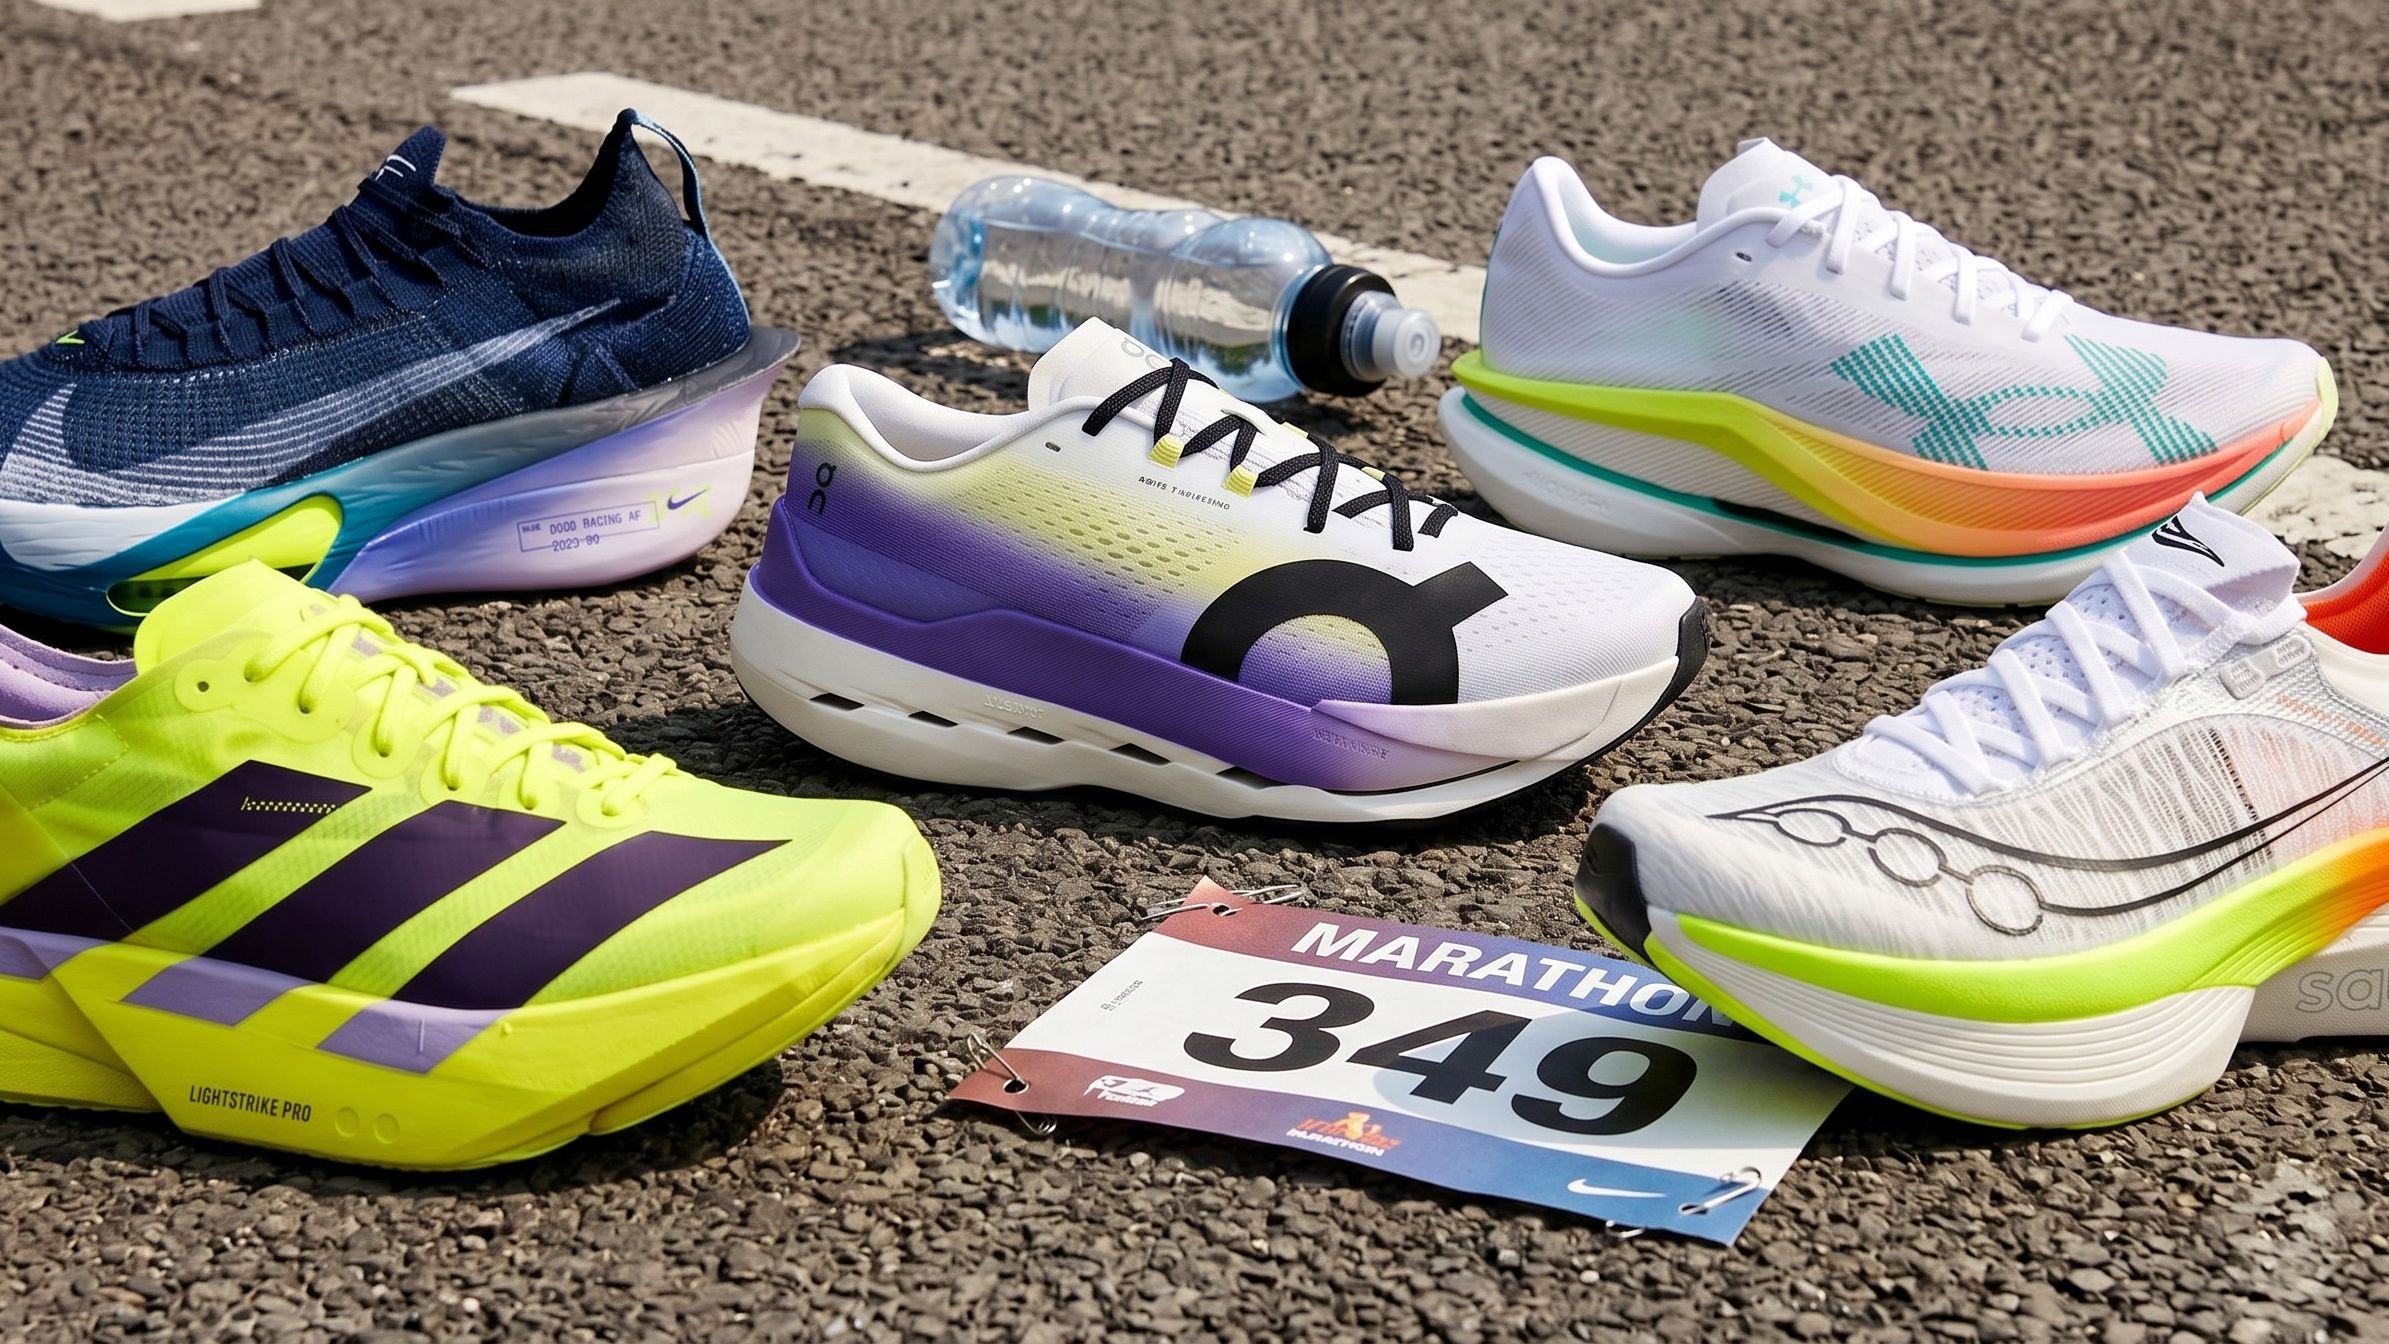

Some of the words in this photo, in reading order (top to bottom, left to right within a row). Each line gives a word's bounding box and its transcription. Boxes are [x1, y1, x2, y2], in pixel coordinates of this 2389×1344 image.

[2295, 969, 2389, 1013] sa
[1183, 981, 1698, 1136] 349
[189, 1085, 279, 1117] LIGHTSTRIKE
[281, 1100, 312, 1123] PRO
